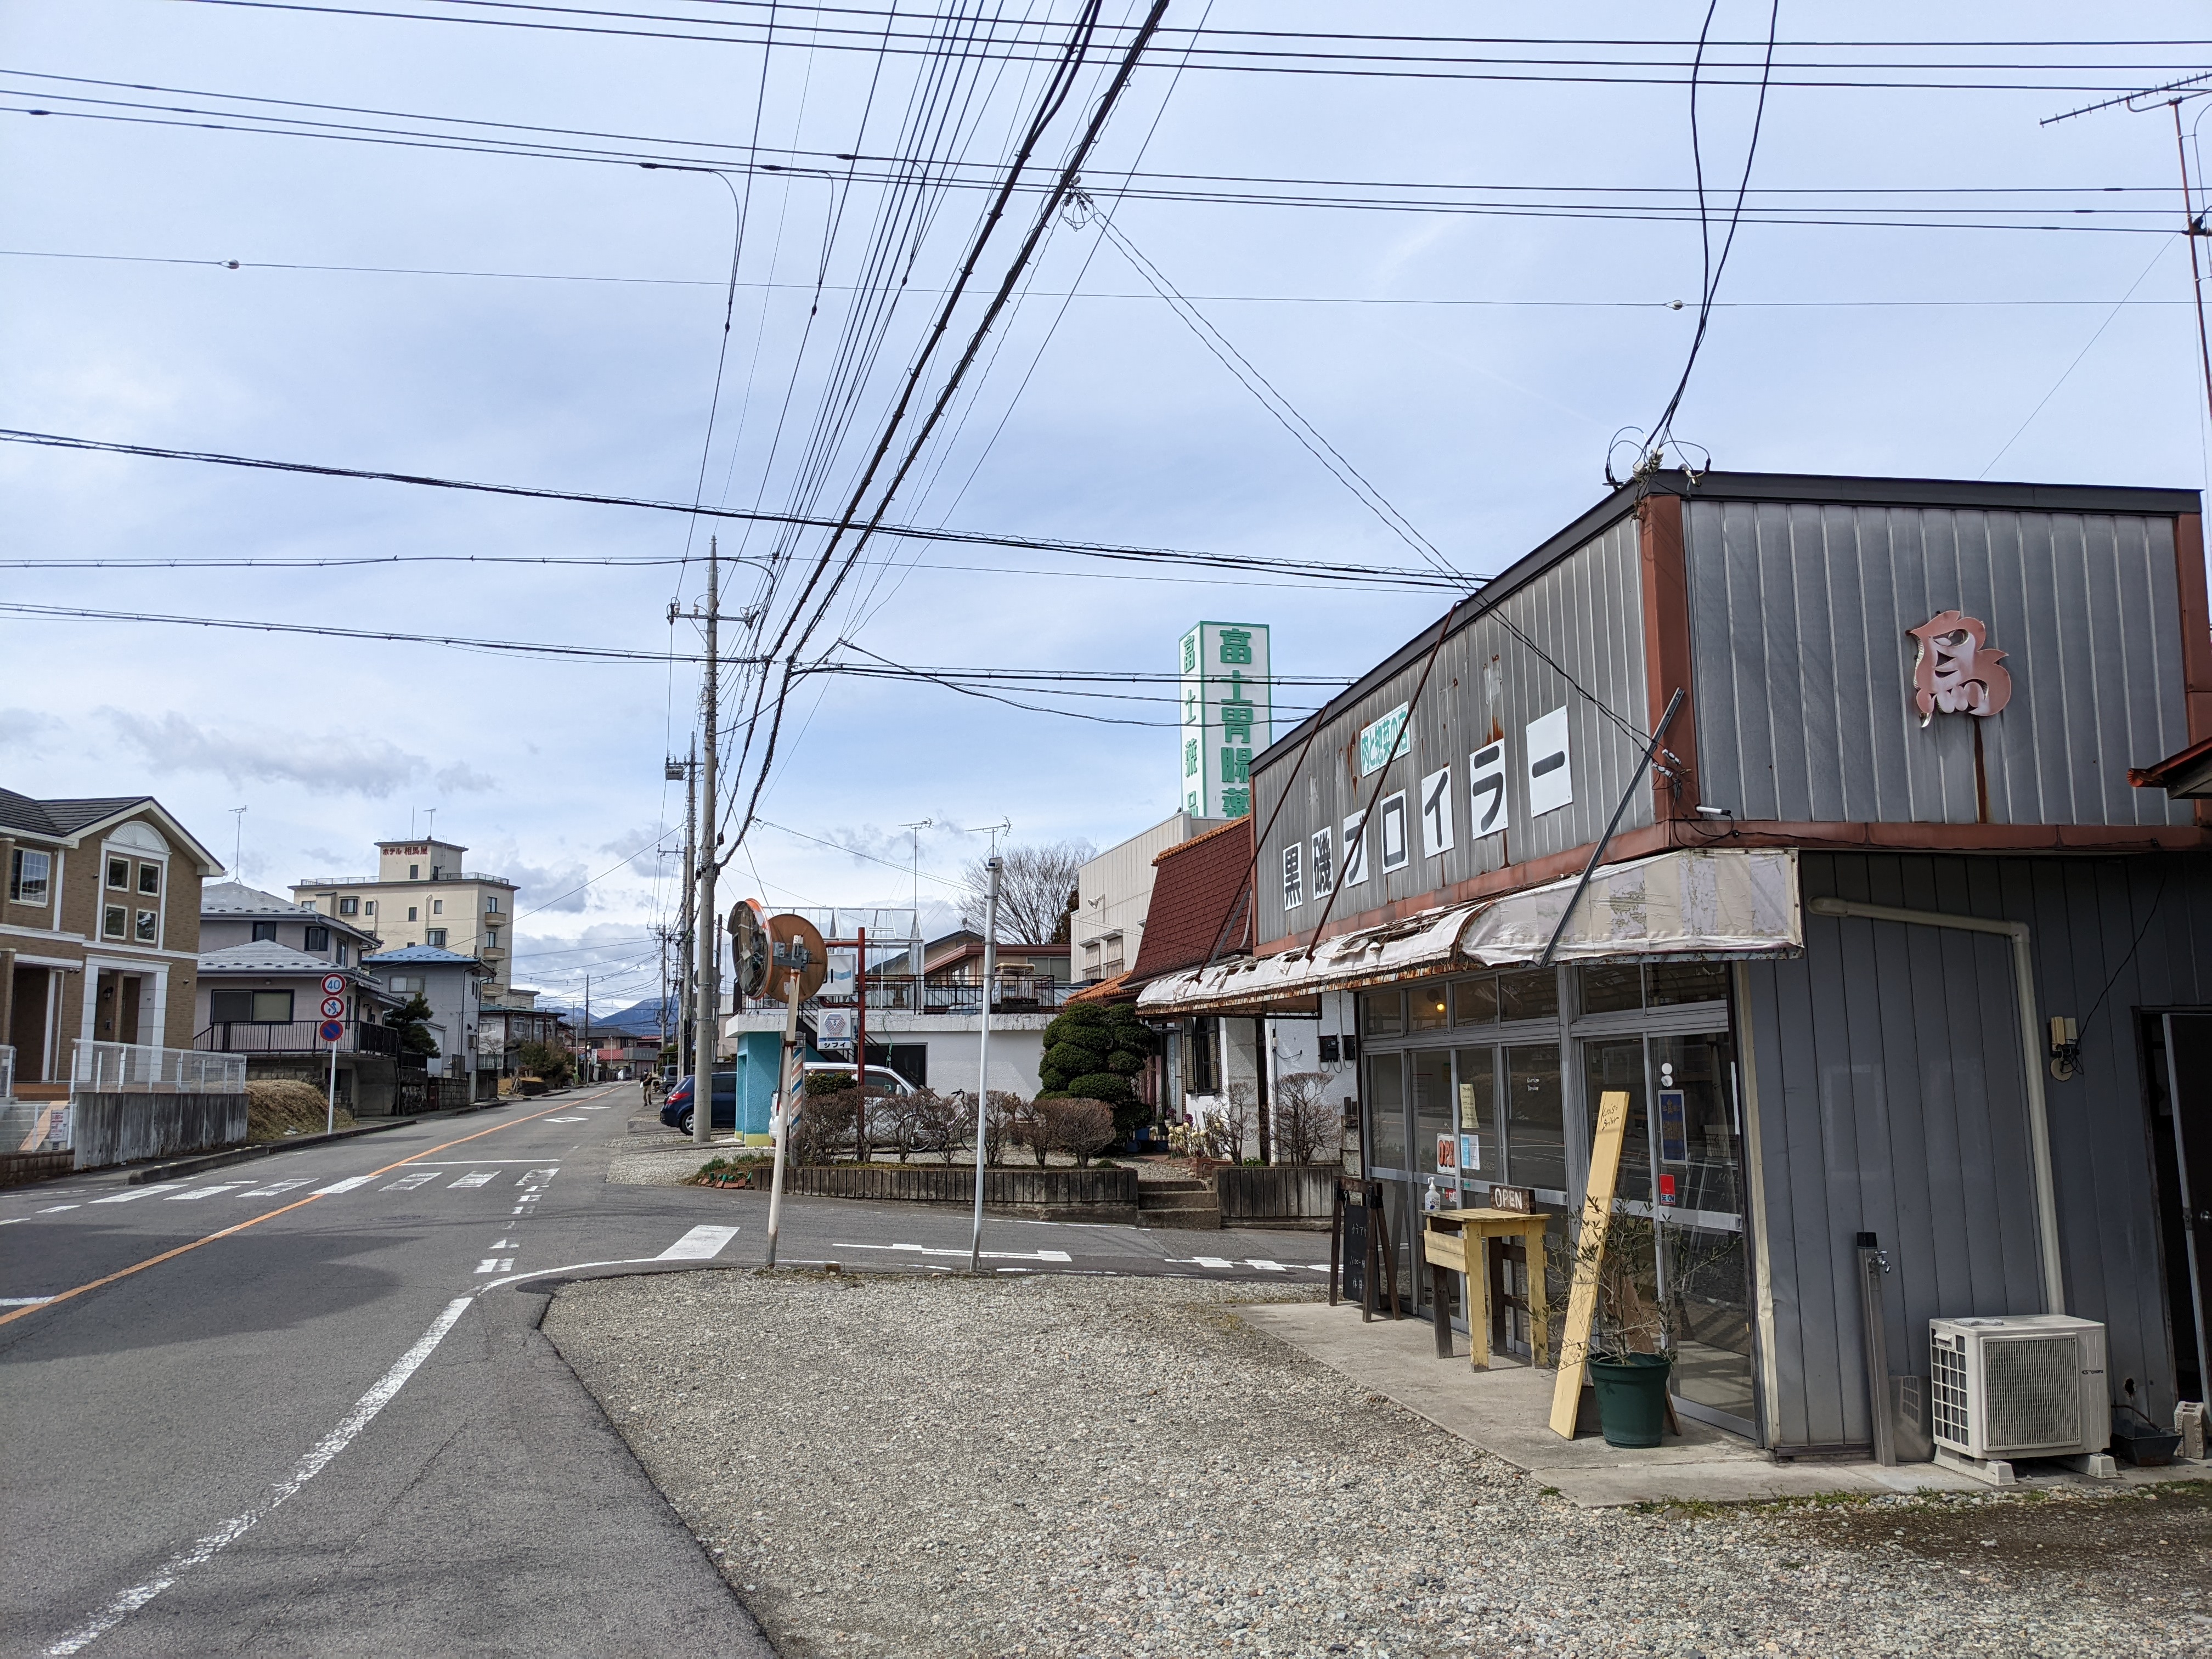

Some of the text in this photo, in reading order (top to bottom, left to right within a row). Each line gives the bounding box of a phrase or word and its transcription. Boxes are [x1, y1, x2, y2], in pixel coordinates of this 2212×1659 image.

[1284, 747, 1565, 908] 黒磯ブロイラー
[404, 846, 427, 855] 相馬屋
[327, 980, 340, 989] 40
[1438, 1139, 1455, 1168] OPE
[1494, 1188, 1522, 1210] OPEN
